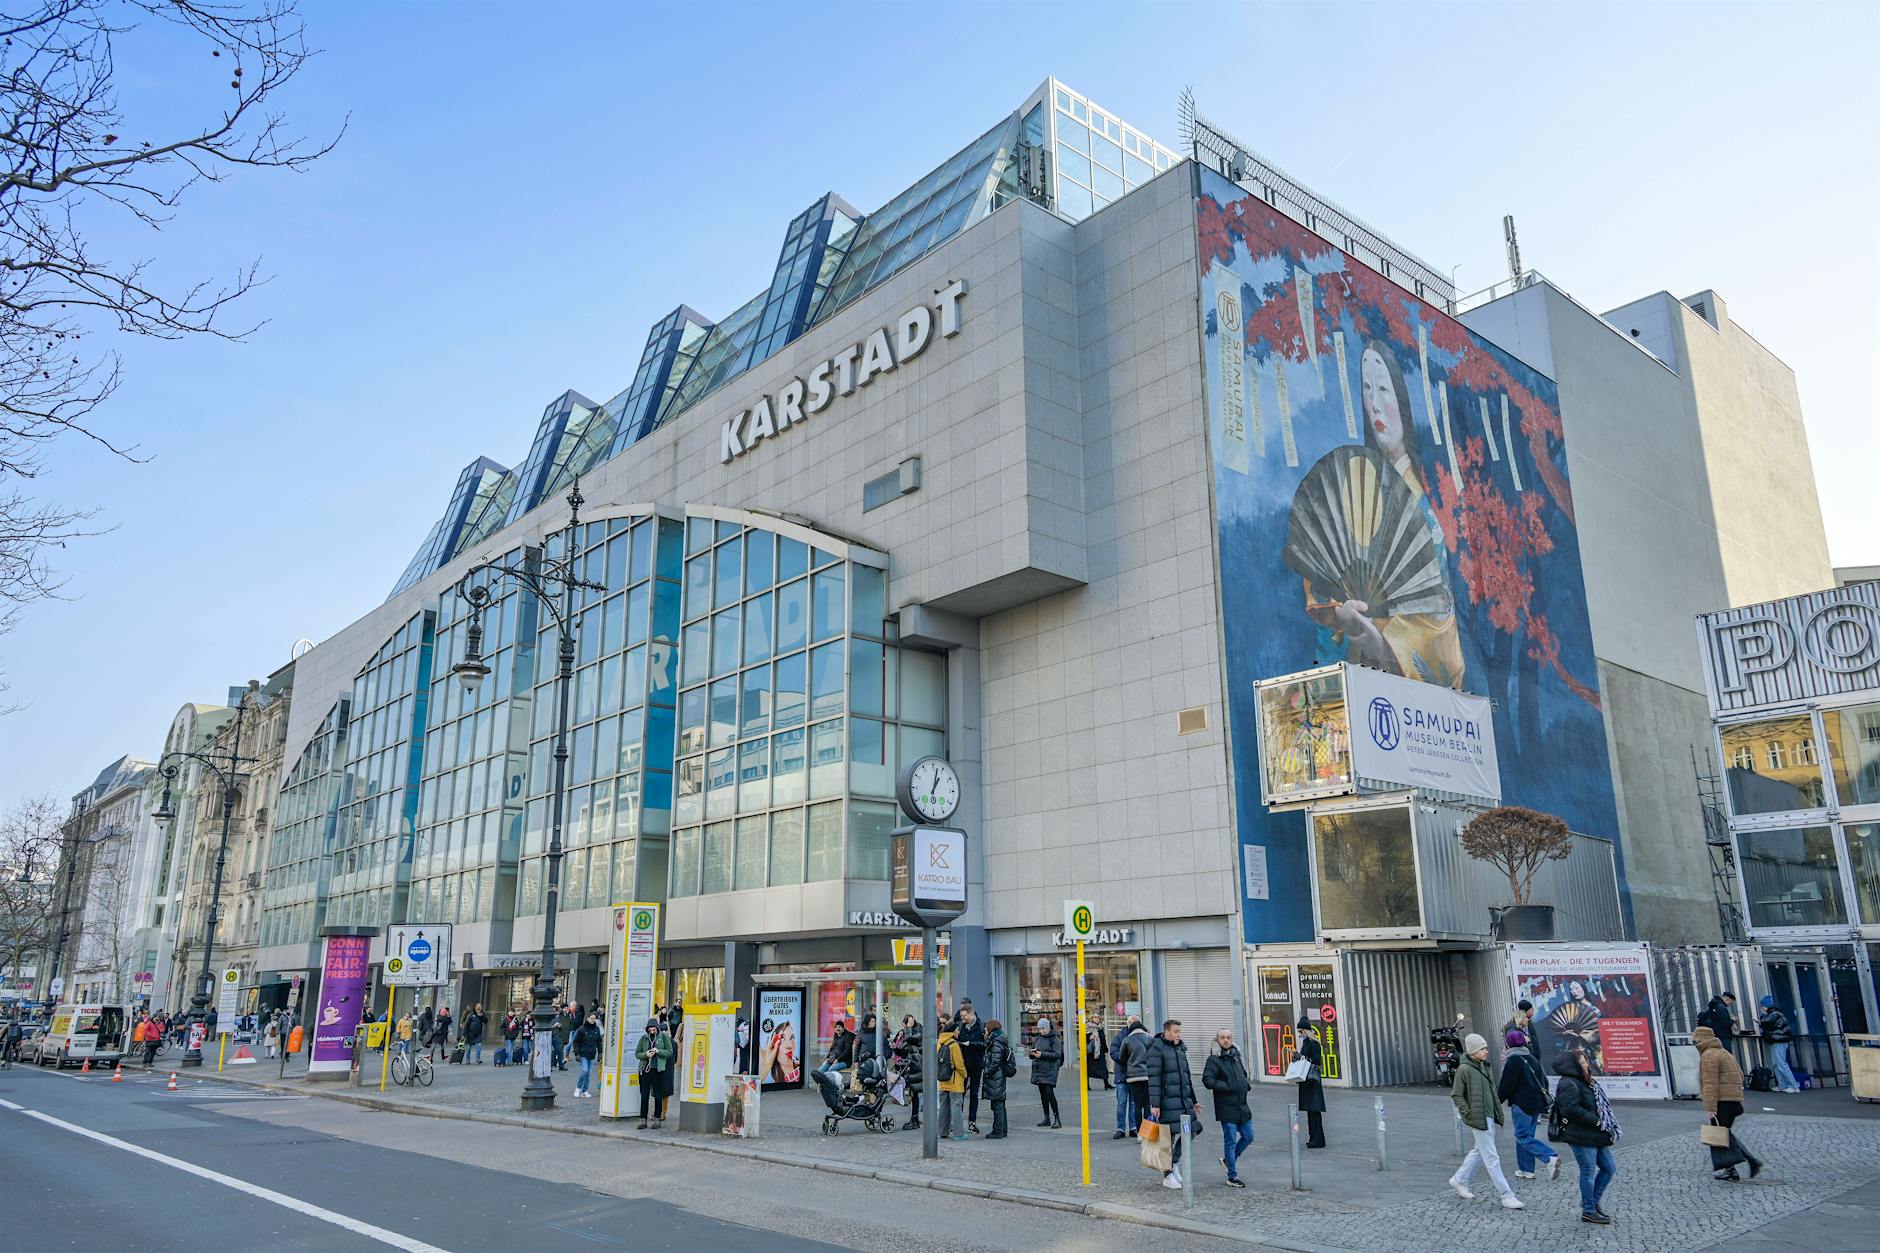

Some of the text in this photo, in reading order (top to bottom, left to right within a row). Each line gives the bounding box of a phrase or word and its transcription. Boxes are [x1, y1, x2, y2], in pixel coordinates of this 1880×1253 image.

[720, 279, 968, 464] KARSTADT
[1233, 339, 1244, 441] SAMURAI
[1403, 707, 1481, 740] SAMURAI
[1405, 731, 1482, 754] MUSEUM BERLIN
[918, 873, 962, 885] KATRO BAU
[328, 949, 342, 957] DIR
[326, 957, 363, 970] FAIR-
[1593, 957, 1640, 965] TUGENDEN
[325, 970, 361, 979] PRESSO
[1300, 973, 1333, 982] premium
[1302, 991, 1333, 999] skincare
